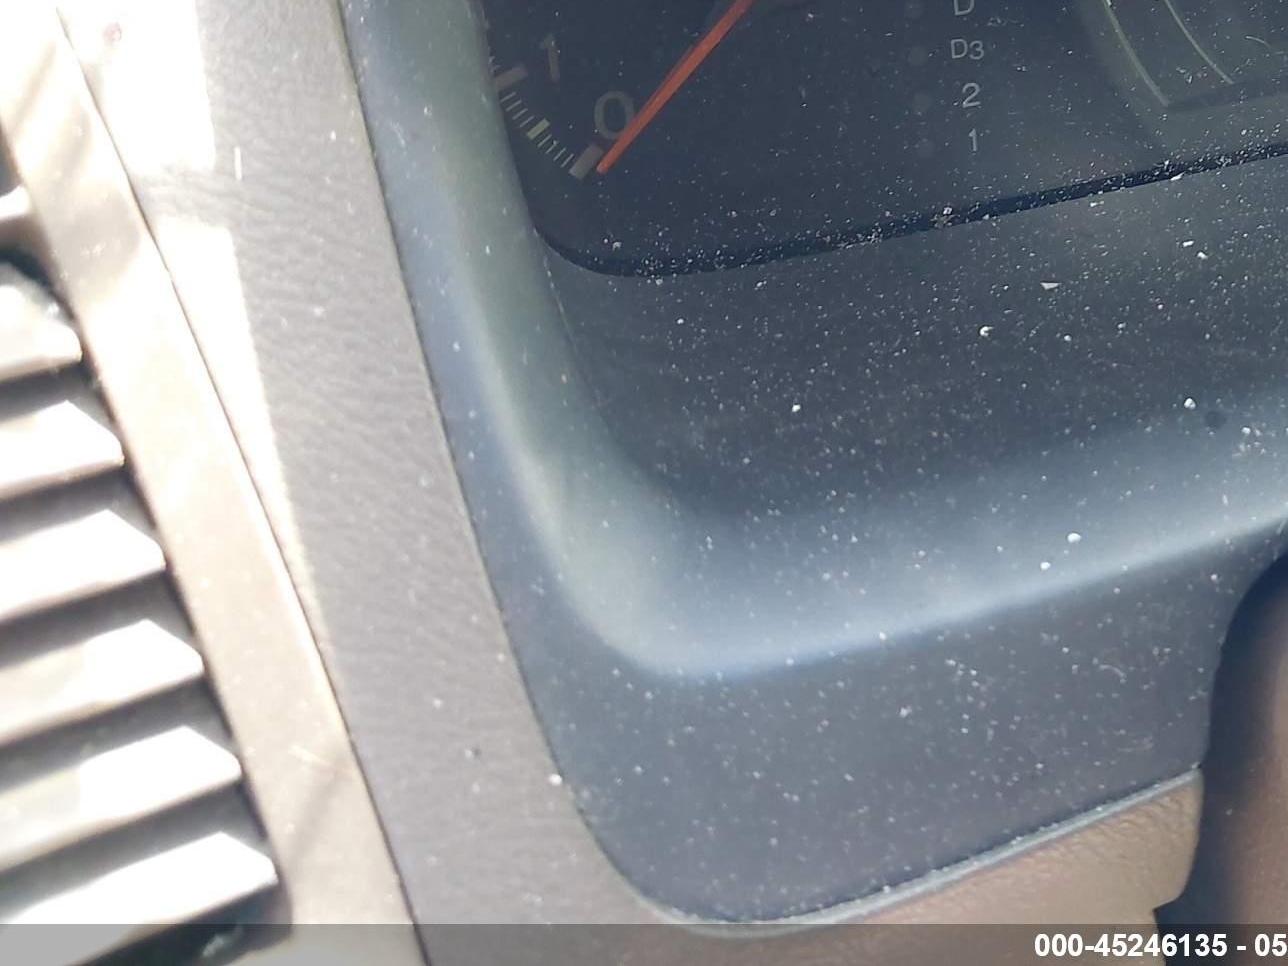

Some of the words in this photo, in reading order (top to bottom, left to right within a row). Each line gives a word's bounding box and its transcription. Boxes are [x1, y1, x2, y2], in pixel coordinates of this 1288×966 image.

[539, 34, 560, 81] 1
[950, 38, 985, 61] D3
[961, 83, 982, 108] 2
[593, 90, 636, 139] 0
[968, 129, 979, 152] 1
